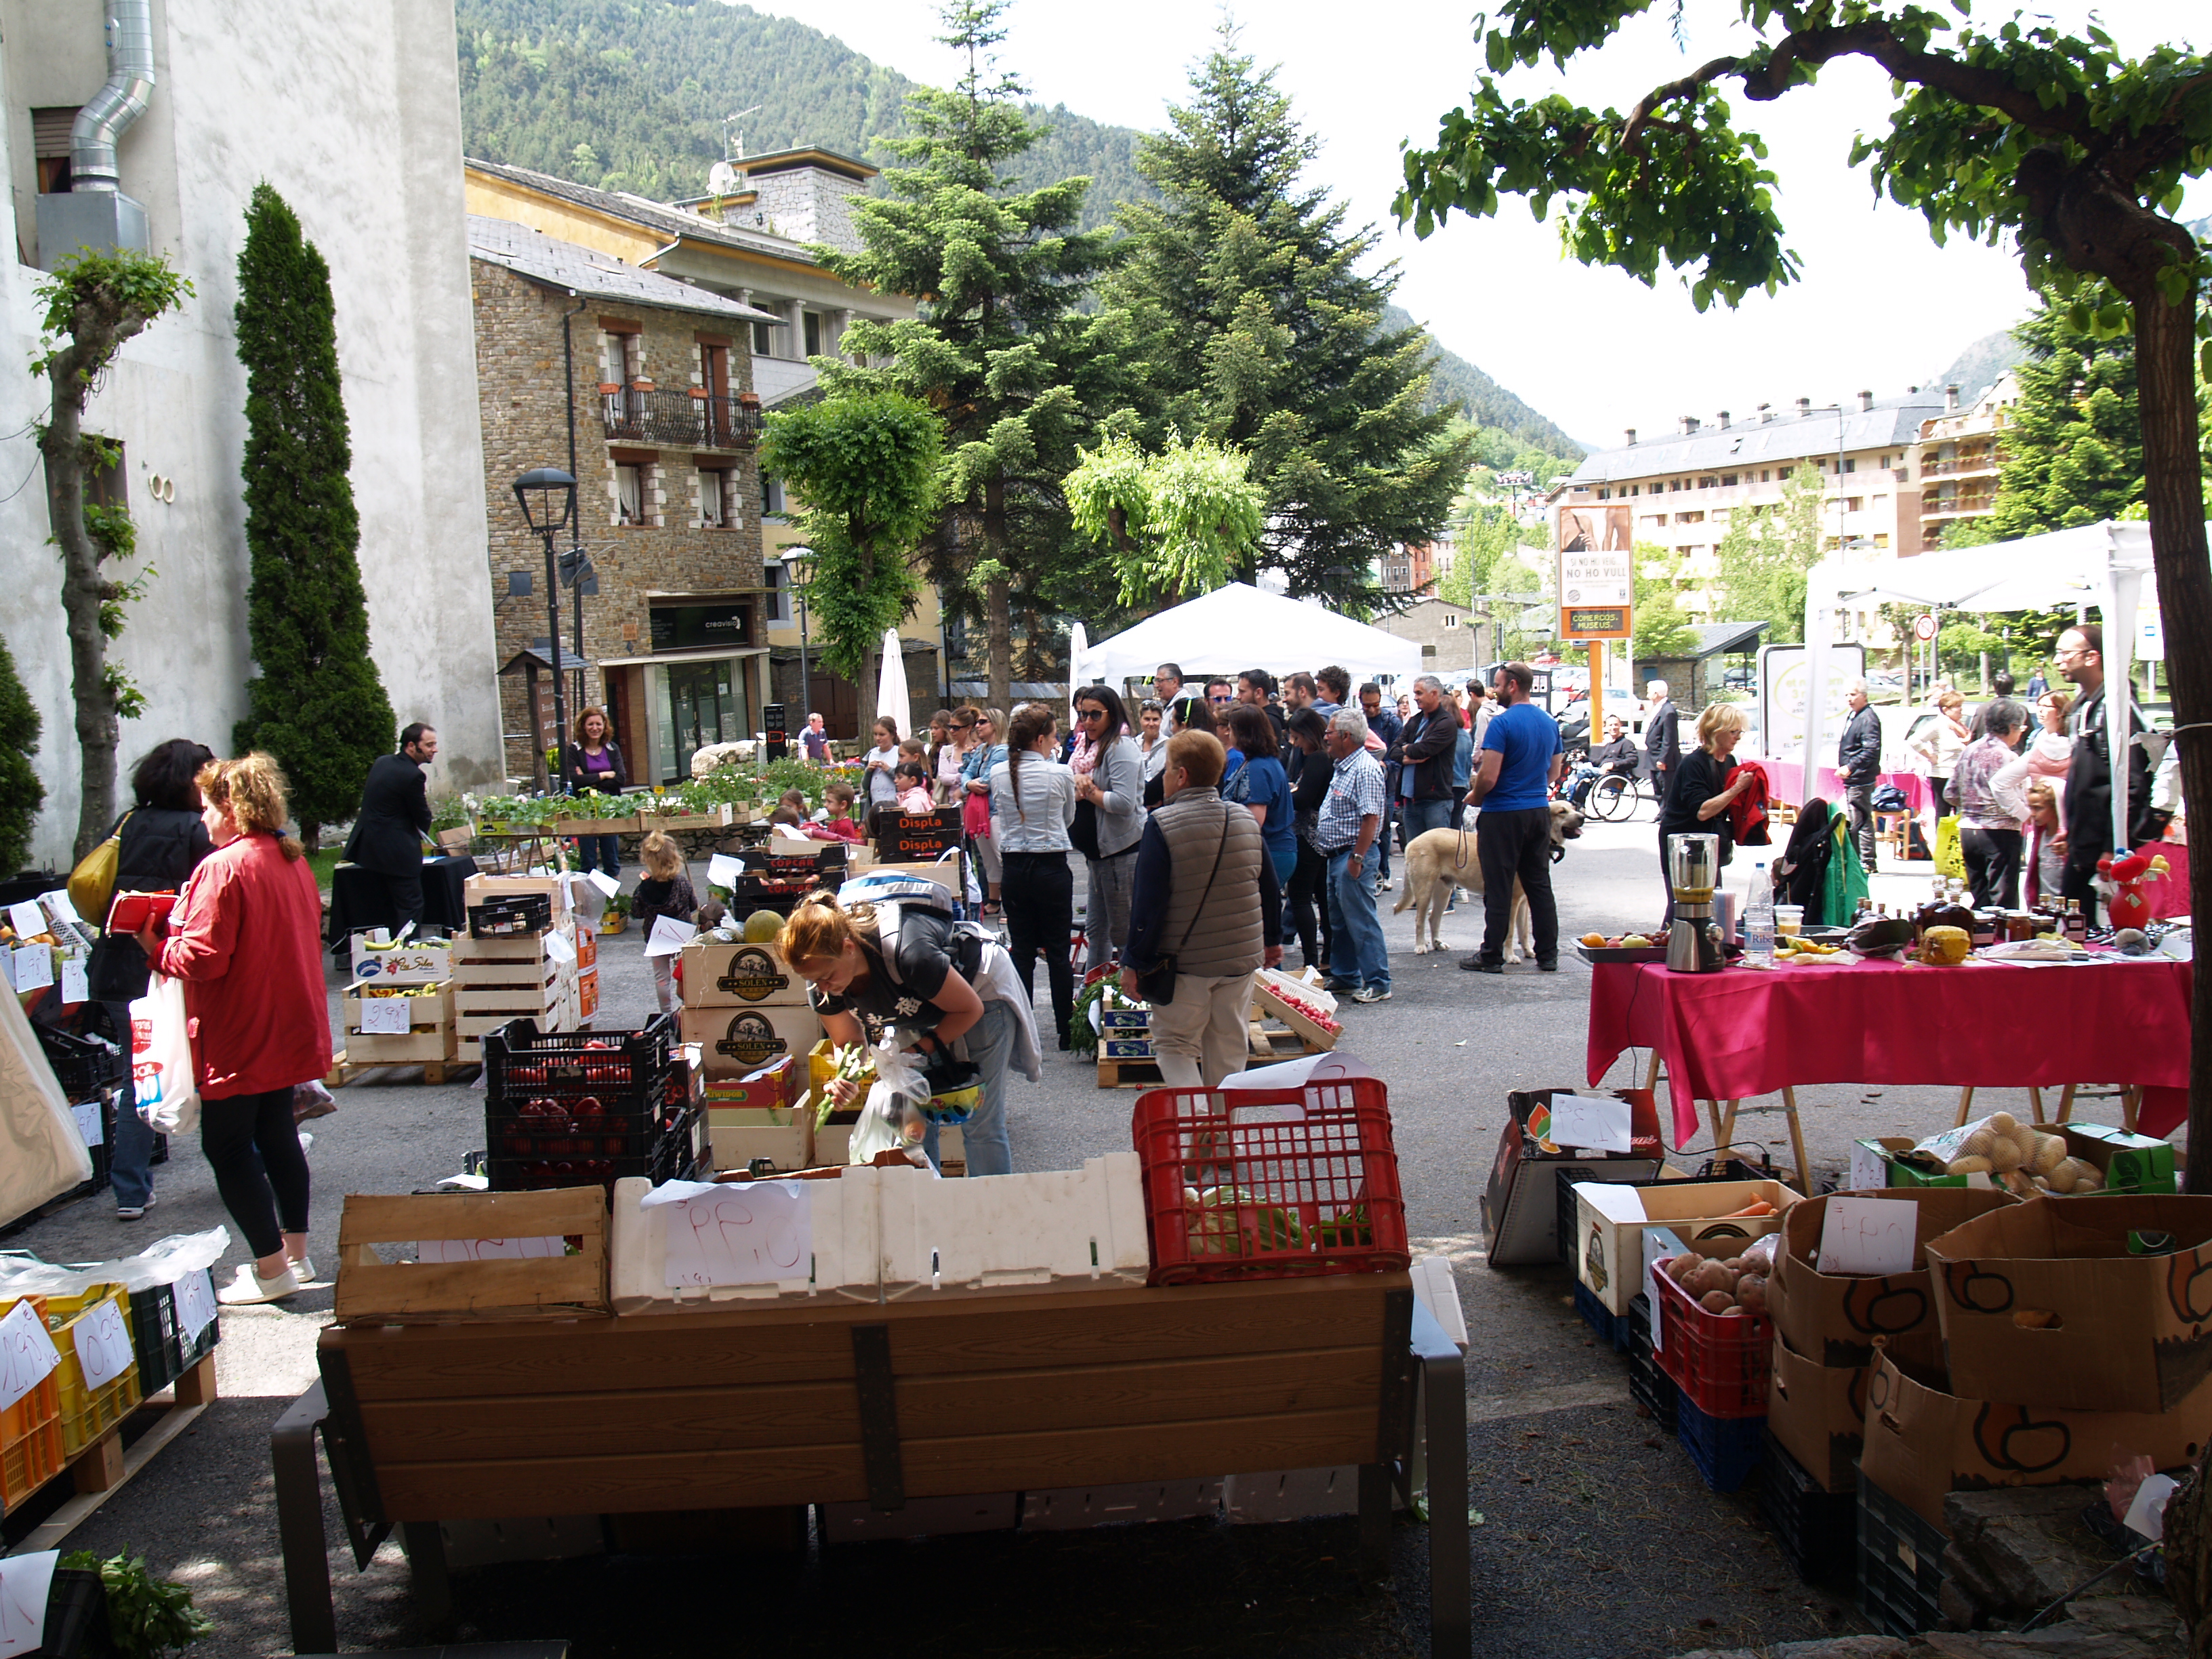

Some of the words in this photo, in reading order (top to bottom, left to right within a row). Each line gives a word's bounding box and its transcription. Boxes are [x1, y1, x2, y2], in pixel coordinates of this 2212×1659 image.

[1579, 558, 1588, 566] NO
[1567, 569, 1580, 578] NO
[1586, 569, 1599, 577] HO
[1603, 568, 1626, 577] VULL
[1578, 621, 1614, 629] MUSEUS.
[899, 817, 942, 829] Displa
[899, 839, 943, 851] Displa
[770, 859, 815, 867] COPCAR
[739, 978, 768, 987] SOLEN
[737, 1042, 766, 1050] SOLEN
